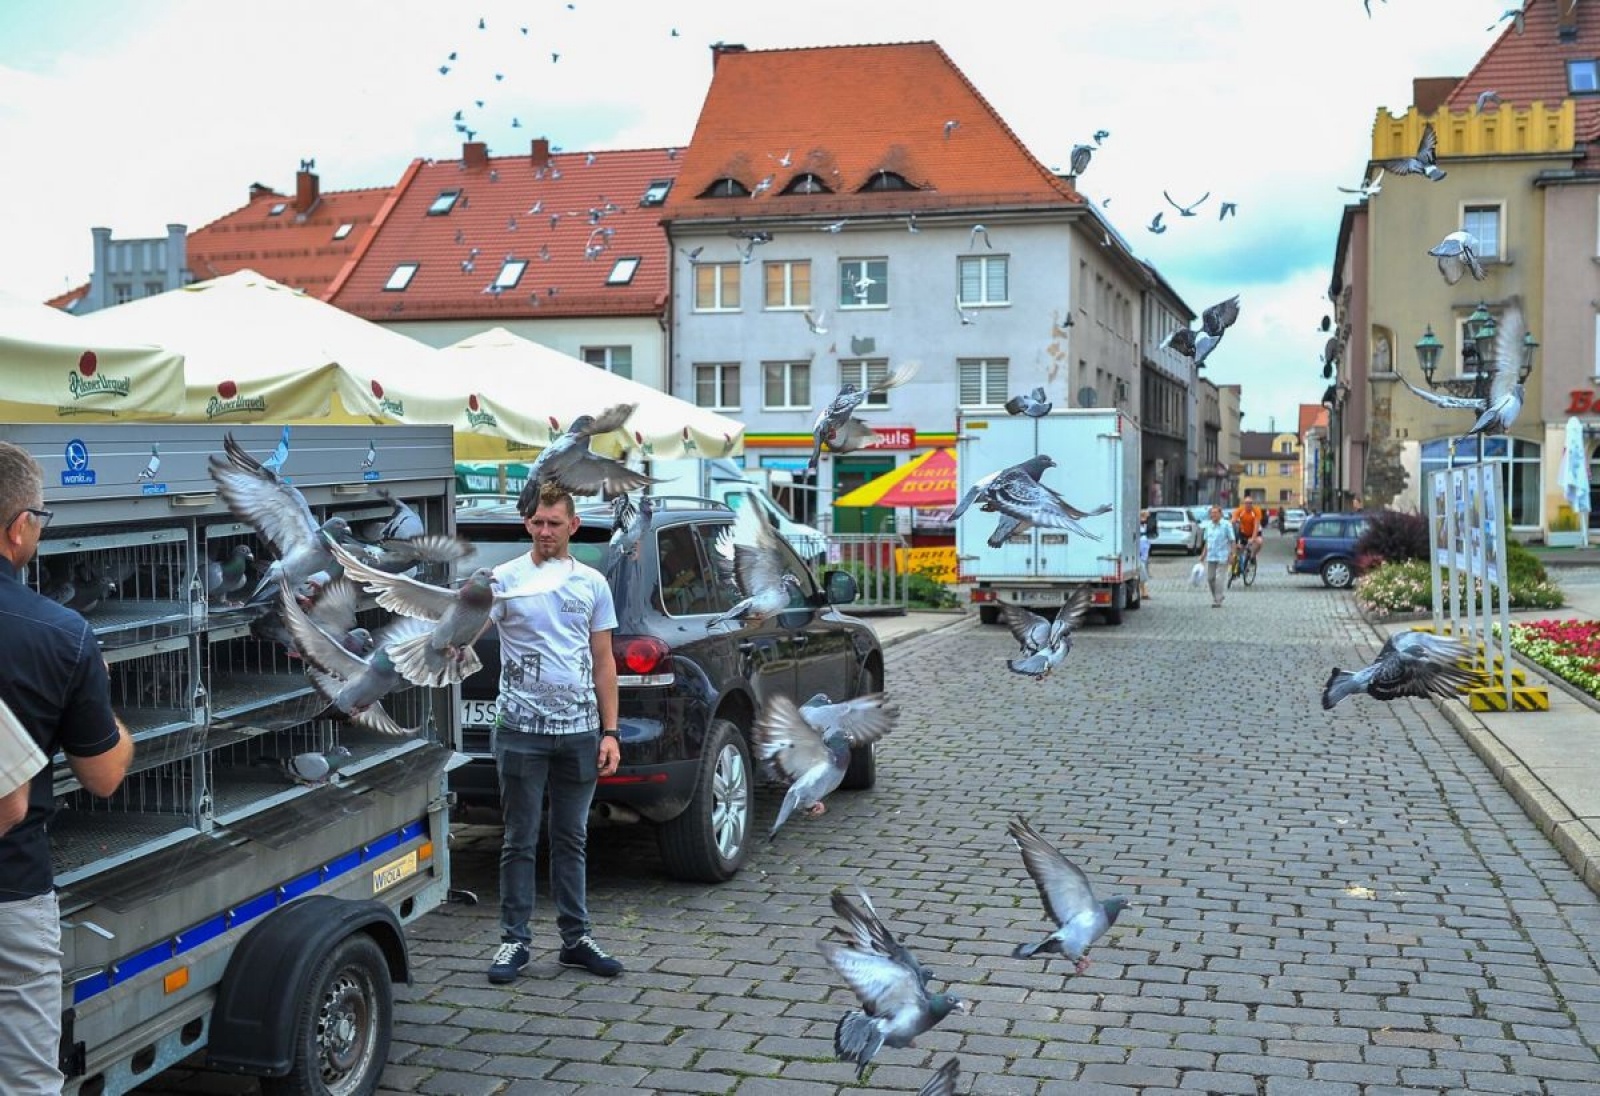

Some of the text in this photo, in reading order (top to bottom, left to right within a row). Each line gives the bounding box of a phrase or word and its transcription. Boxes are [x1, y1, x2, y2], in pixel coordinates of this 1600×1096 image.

[69, 371, 130, 399] Pilsner Urquell
[206, 395, 236, 418] Pilsner
[875, 430, 911, 448] puls
[910, 467, 956, 477] GRIL
